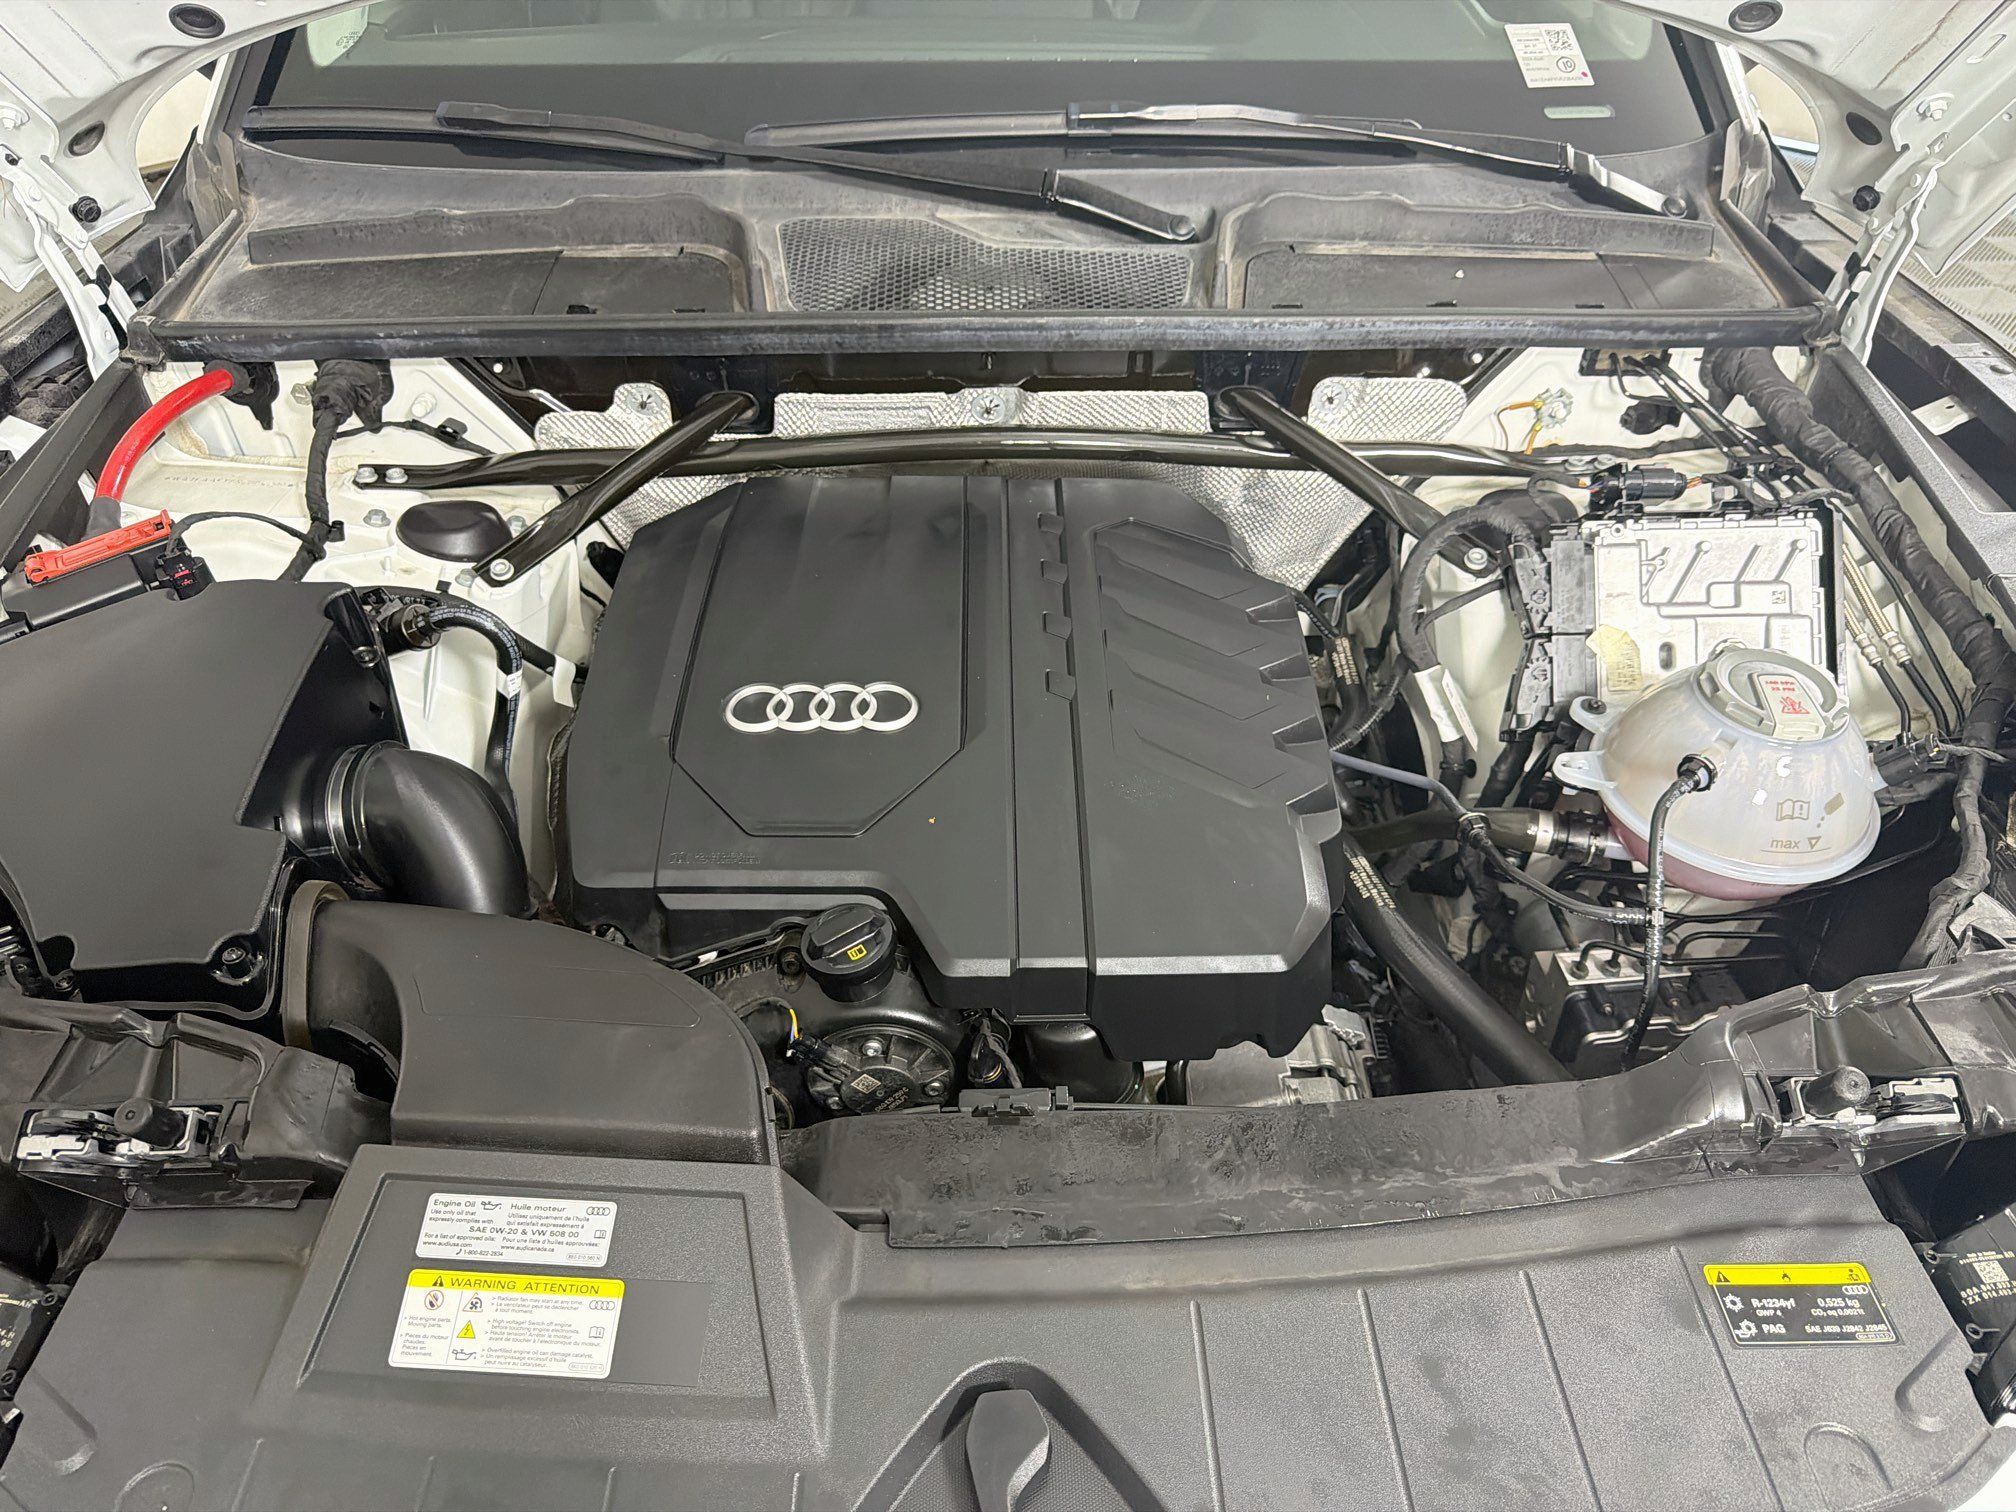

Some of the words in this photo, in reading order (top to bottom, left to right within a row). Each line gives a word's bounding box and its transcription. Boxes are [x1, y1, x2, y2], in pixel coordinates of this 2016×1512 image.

[1770, 838, 1800, 849] max
[433, 1199, 462, 1208] Engine
[510, 1203, 532, 1211] Huile
[468, 1226, 488, 1234] SAE
[490, 1227, 518, 1235] 0W-20
[450, 1278, 517, 1290] WARNING
[524, 1282, 600, 1294] ATTENTION
[1750, 1298, 1796, 1310] R-1234yf
[1847, 1298, 1860, 1308] kg
[1762, 1324, 1786, 1334] PAG
